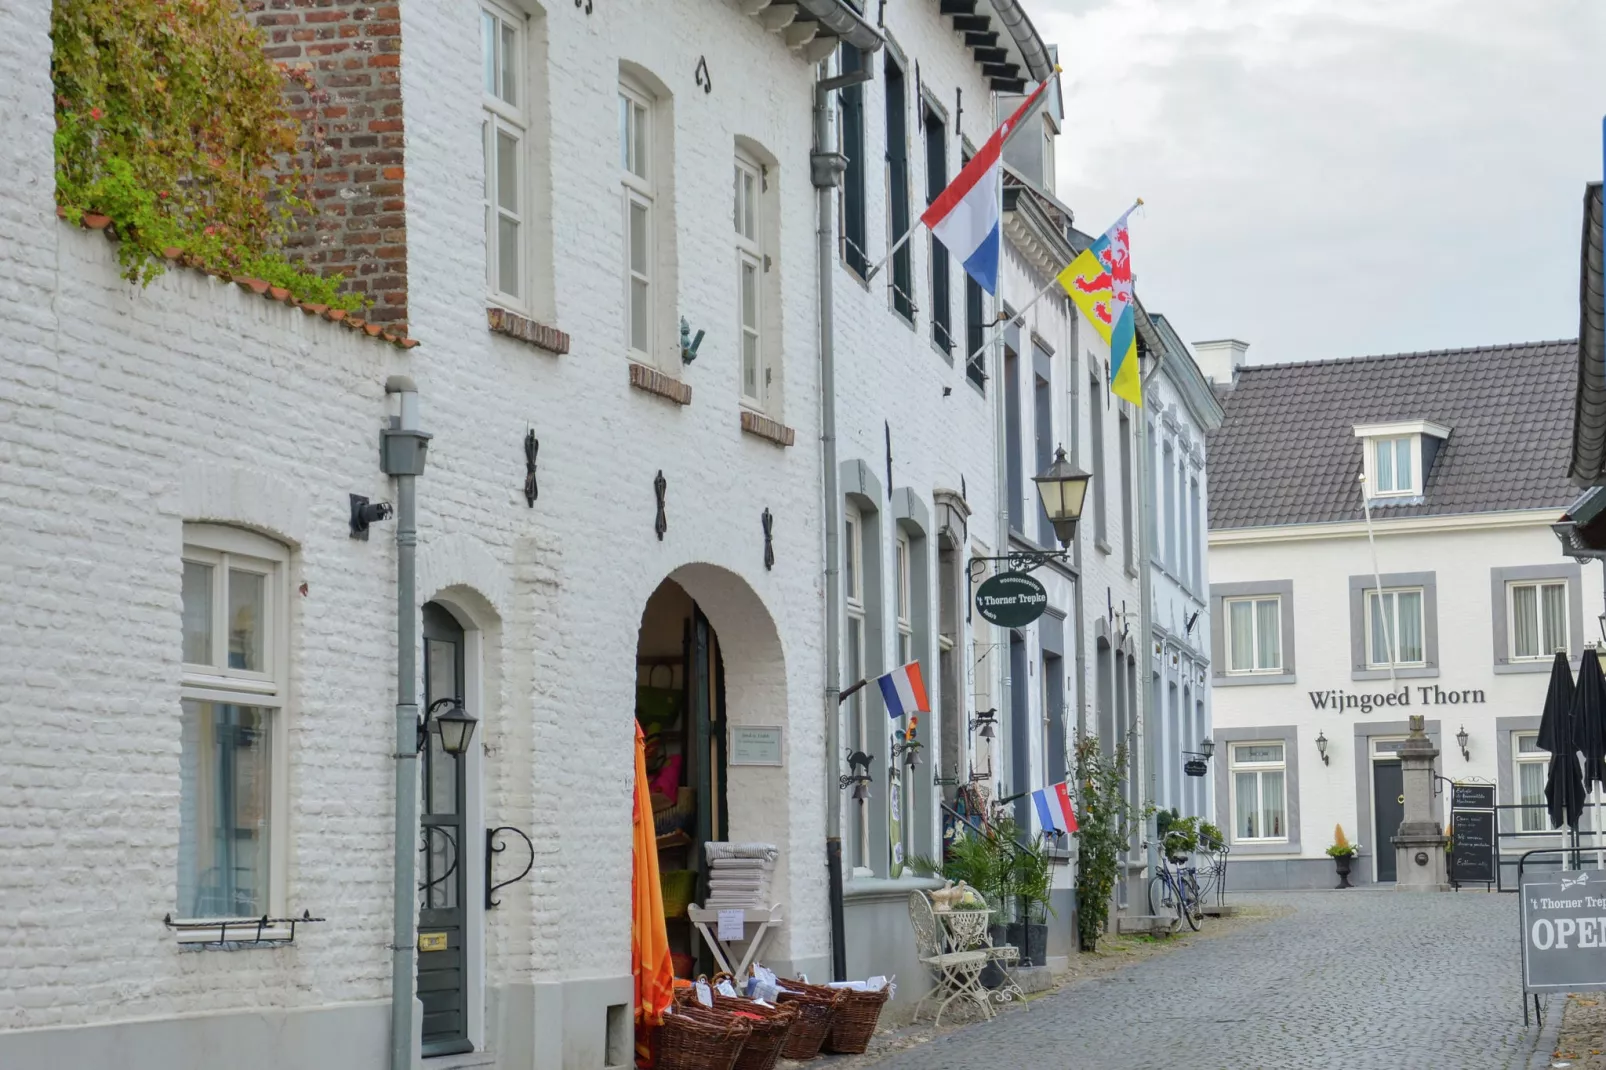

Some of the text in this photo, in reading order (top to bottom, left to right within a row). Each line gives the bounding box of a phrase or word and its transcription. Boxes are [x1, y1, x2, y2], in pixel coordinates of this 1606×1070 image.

[976, 592, 1046, 606] 't Thorner Trepke
[1308, 684, 1486, 714] Wijngoed Thorn
[1530, 898, 1538, 909] 't
[1540, 897, 1582, 909] Thorner
